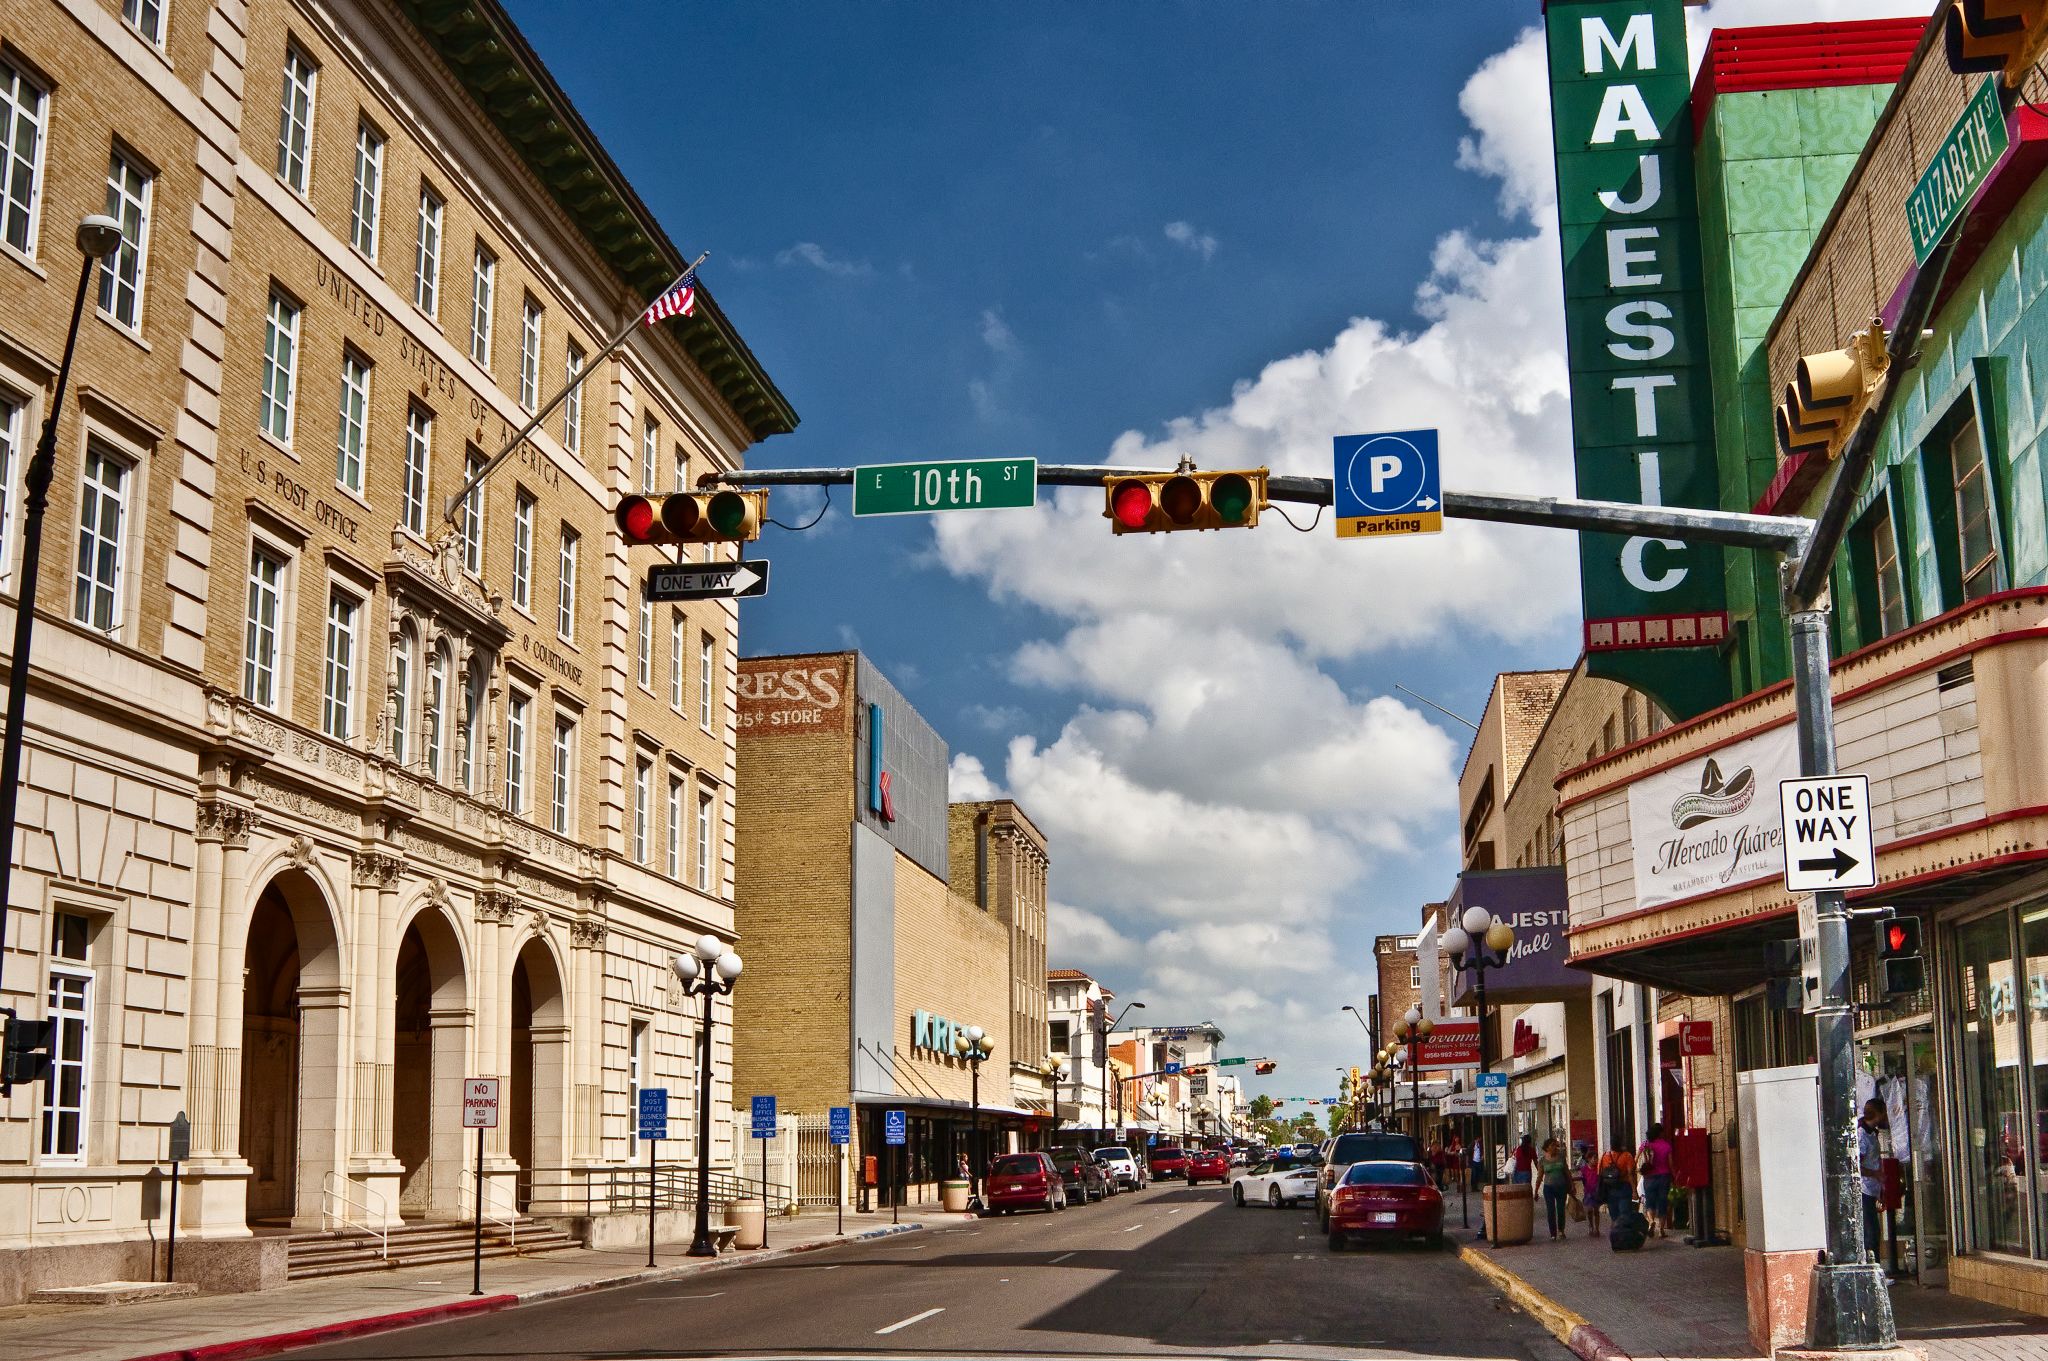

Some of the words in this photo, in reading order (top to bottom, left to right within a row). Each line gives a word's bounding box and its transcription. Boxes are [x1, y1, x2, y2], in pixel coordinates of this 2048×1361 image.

[1909, 206, 1917, 227] E
[1914, 103, 1993, 249] ELIZABETH
[1983, 90, 1995, 119] ST
[1581, 14, 1689, 592] MAJESTIC
[317, 258, 385, 337] UNITED
[400, 336, 456, 400] STATES
[470, 397, 488, 426] OF
[875, 473, 883, 489] E
[912, 468, 983, 507] 10th
[1003, 465, 1019, 481] ST
[1370, 455, 1403, 494] P
[275, 471, 309, 511] POST
[316, 500, 358, 544] OFFICE
[1356, 518, 1421, 533] Parking
[661, 575, 693, 591] ONE
[701, 573, 734, 589] WAY
[533, 641, 583, 687] COURTHOUSE
[770, 708, 822, 726] STORE
[1796, 785, 1855, 813] ONE
[1795, 815, 1858, 843] WAY
[1651, 829, 1728, 875] Mercado
[1802, 904, 1815, 933] ONE
[1505, 932, 1552, 964] Mall
[1803, 936, 1818, 964] WAY
[915, 1008, 990, 1059] KRE
[465, 1098, 497, 1108] PARKING
[474, 1083, 489, 1095] NO
[473, 1117, 488, 1125] ZONE
